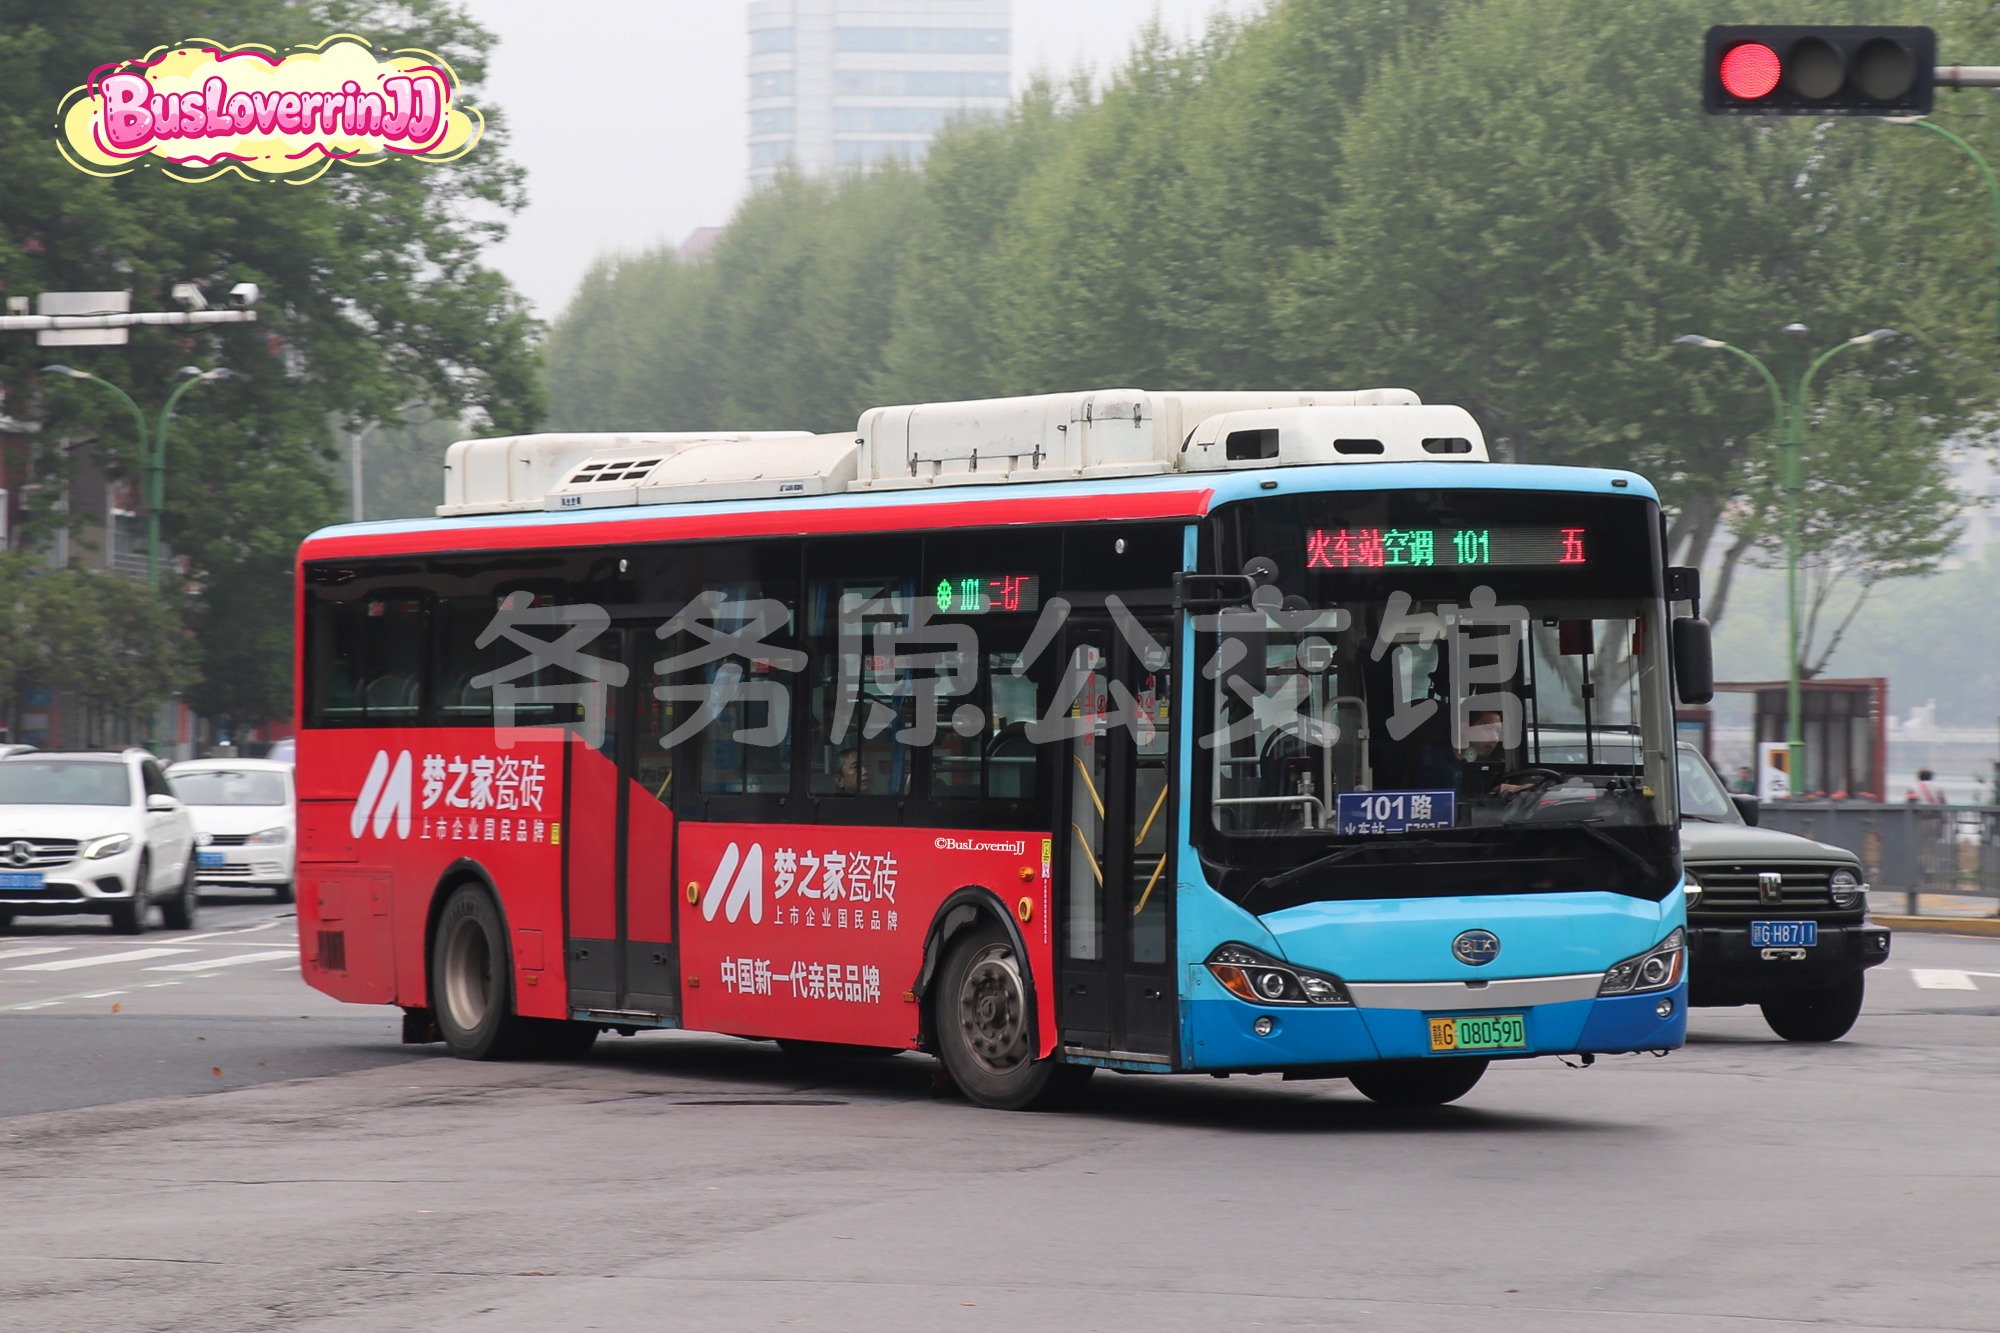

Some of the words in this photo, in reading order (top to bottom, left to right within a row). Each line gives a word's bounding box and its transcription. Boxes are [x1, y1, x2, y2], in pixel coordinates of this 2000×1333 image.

[1453, 529, 1490, 564] 101
[1559, 528, 1586, 563] 五
[960, 578, 980, 611] 101
[421, 754, 546, 812] 梦之家瓷砖
[420, 816, 545, 843] 上市企业国民品牌
[773, 848, 898, 904] 梦之家瓷砖
[773, 905, 898, 931] 上市企业国民品牌
[720, 956, 881, 1004] 中国新一代亲民品牌
[1460, 1020, 1523, 1045] 08059D
